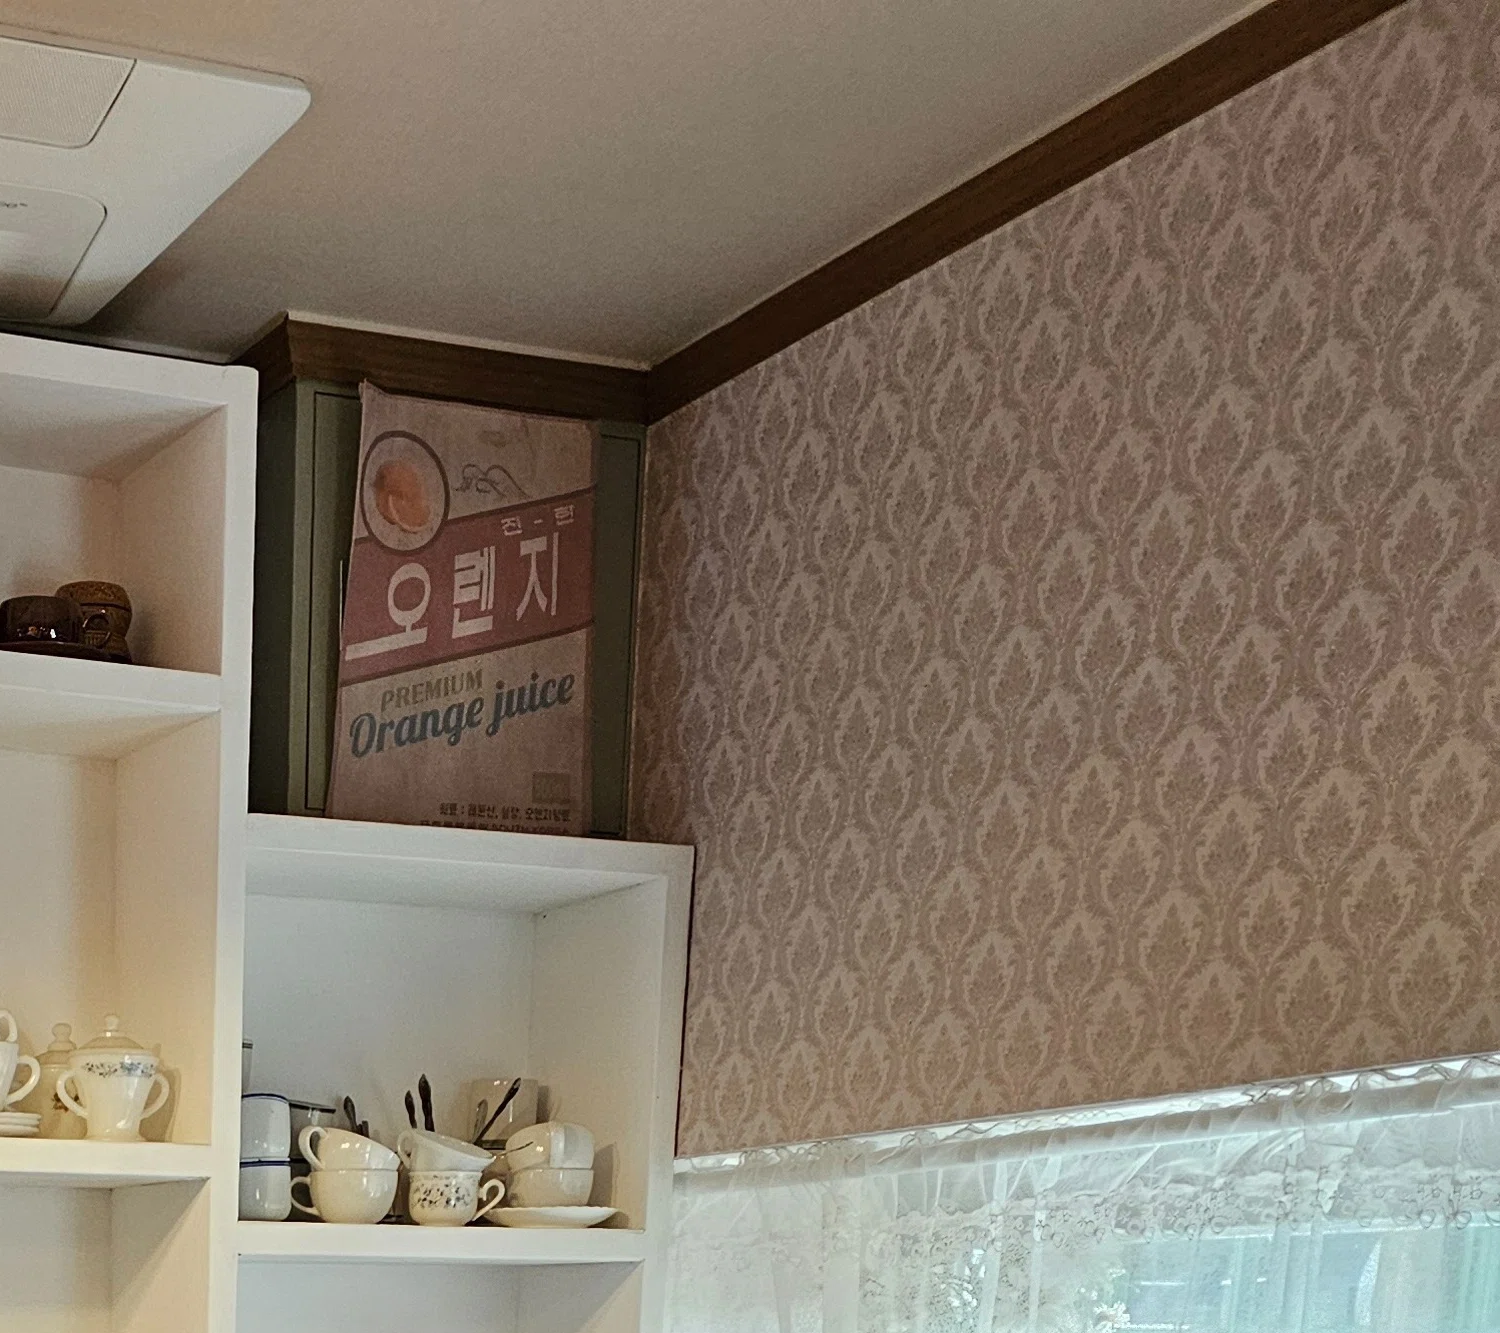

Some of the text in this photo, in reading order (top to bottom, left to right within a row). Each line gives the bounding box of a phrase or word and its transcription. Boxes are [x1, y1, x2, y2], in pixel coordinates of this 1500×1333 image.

[344, 532, 560, 661] 오렌지
[349, 671, 576, 758] Orange juice
[380, 668, 484, 713] PREMIUM
